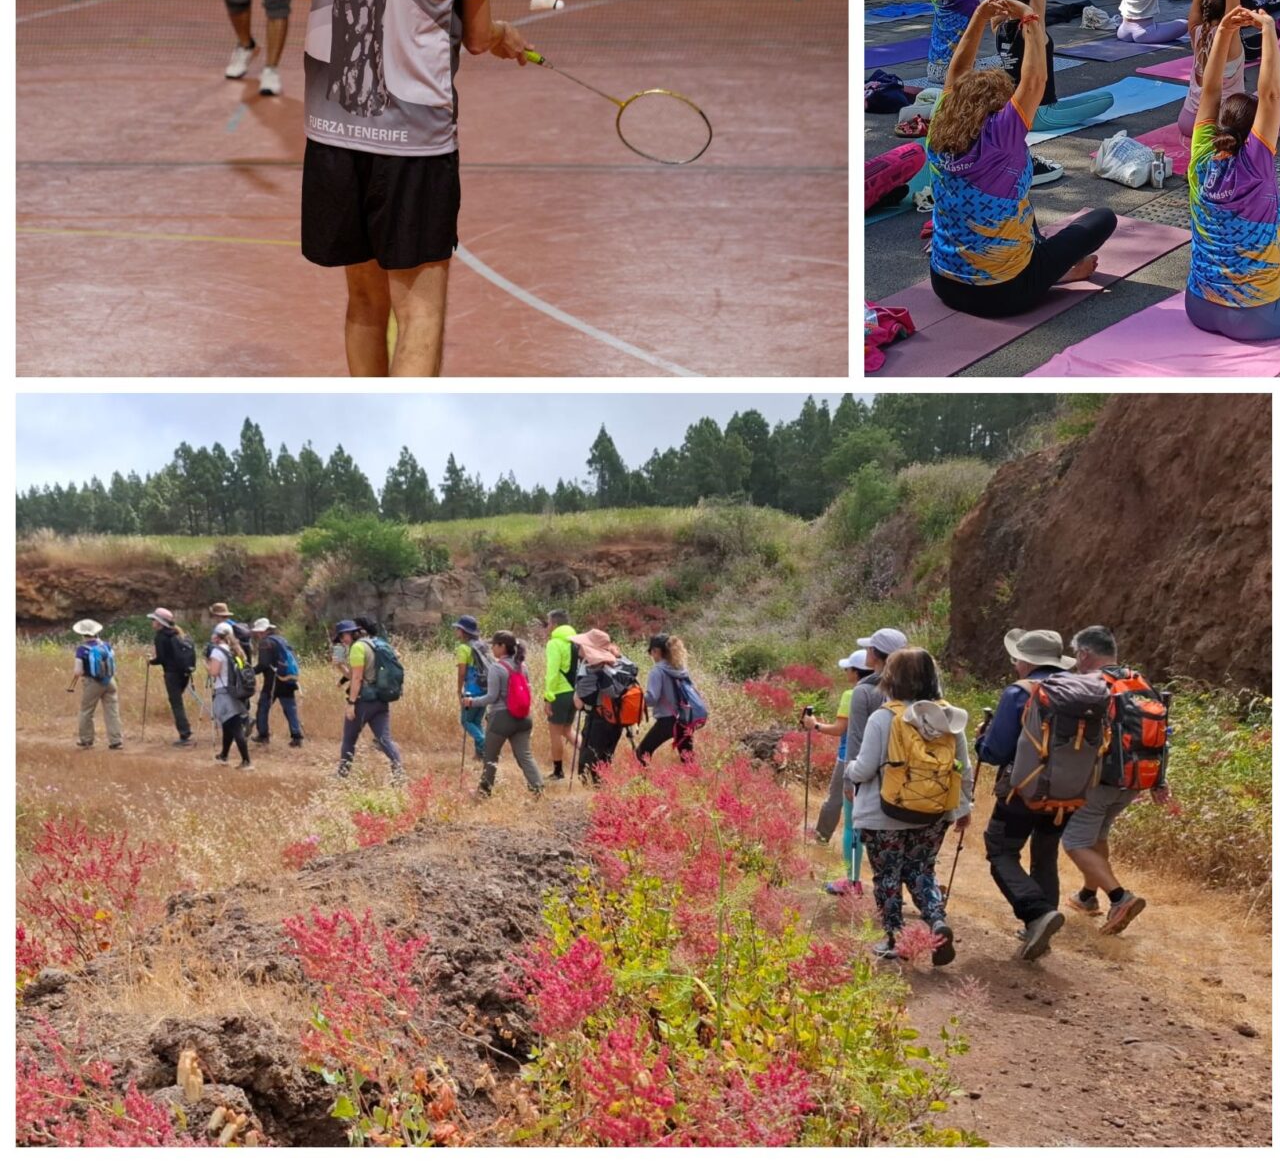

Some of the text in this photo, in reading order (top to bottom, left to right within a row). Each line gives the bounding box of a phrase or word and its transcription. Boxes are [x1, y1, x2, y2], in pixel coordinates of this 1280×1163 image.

[309, 115, 409, 143] FUERZA TENERIFE
[1208, 189, 1234, 200] Máste
